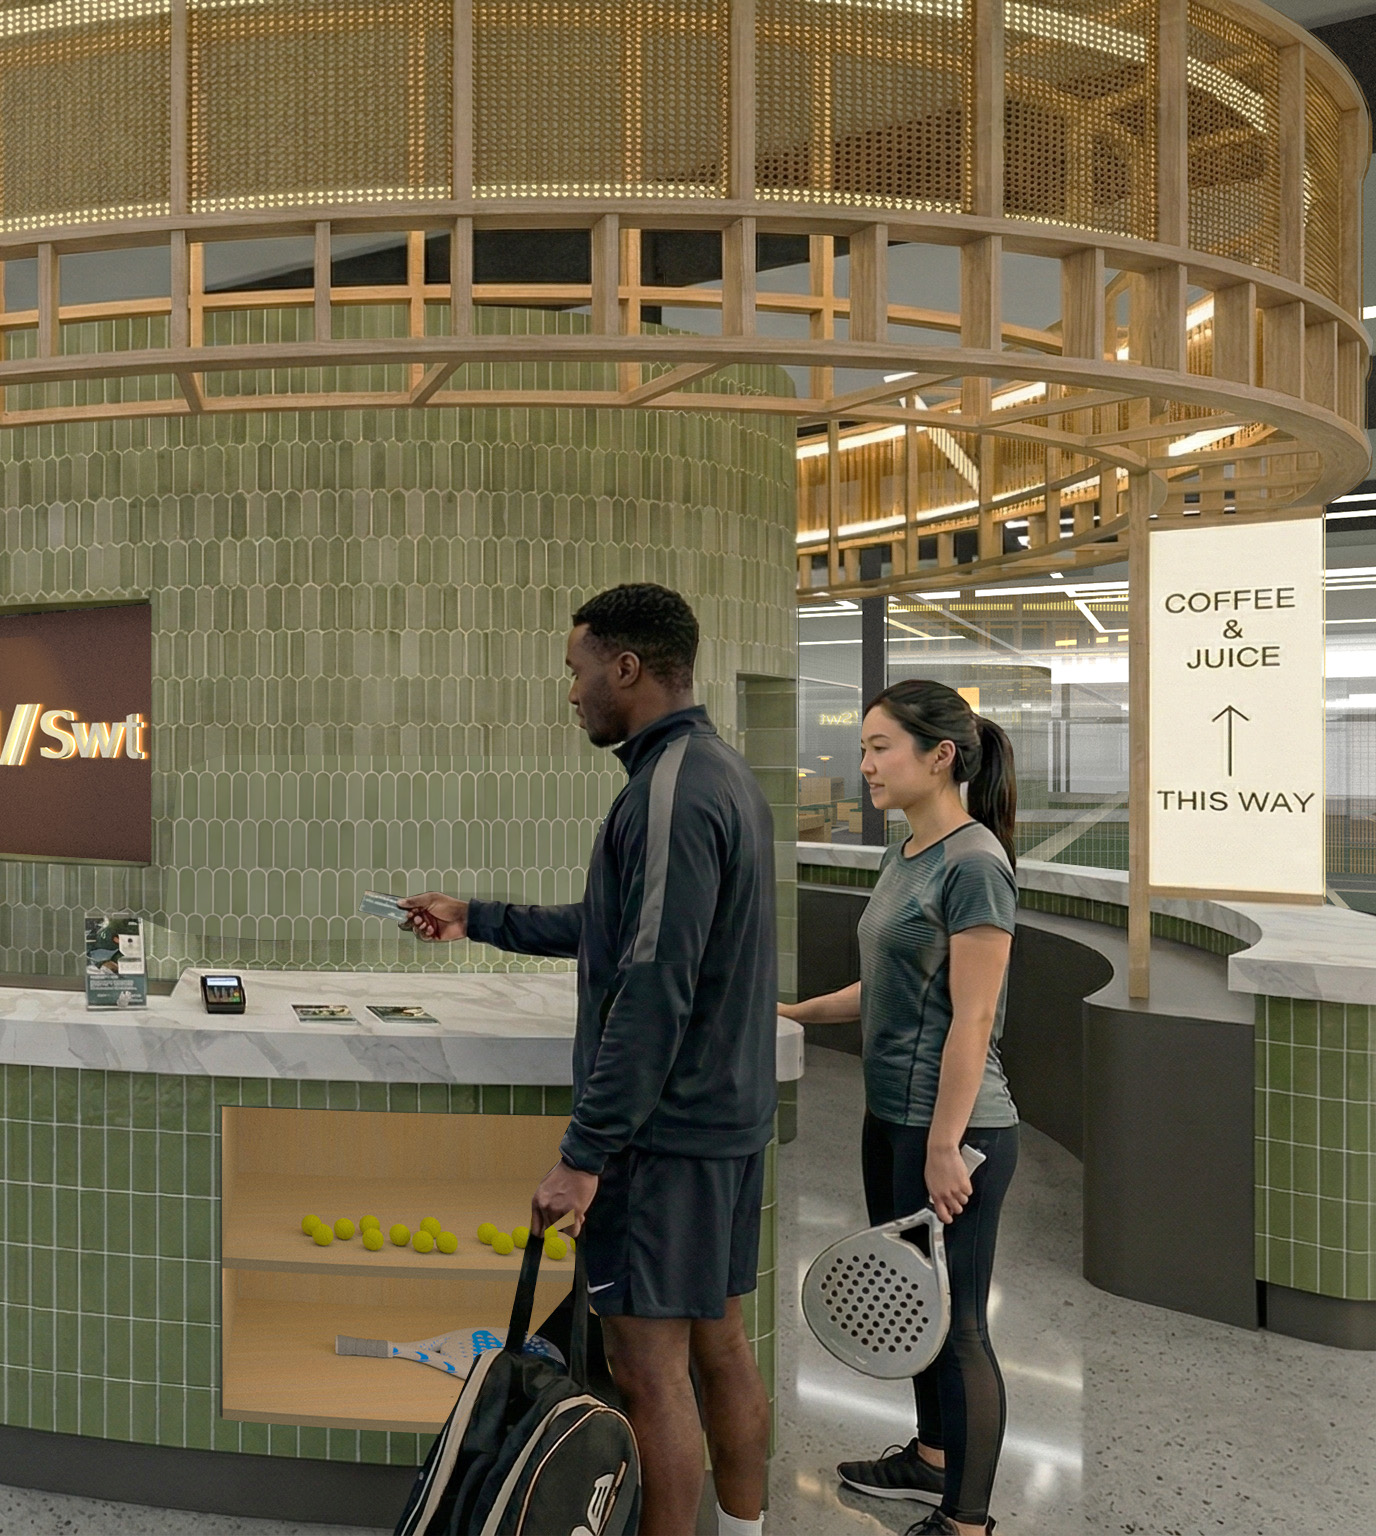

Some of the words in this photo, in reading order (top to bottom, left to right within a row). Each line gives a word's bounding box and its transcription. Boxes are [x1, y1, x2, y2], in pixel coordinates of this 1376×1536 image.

[1165, 587, 1296, 614] COFFEE
[1222, 619, 1243, 639] &
[1186, 646, 1281, 669] JUICE
[1157, 790, 1228, 811] THIS
[1238, 791, 1315, 813] WAY
